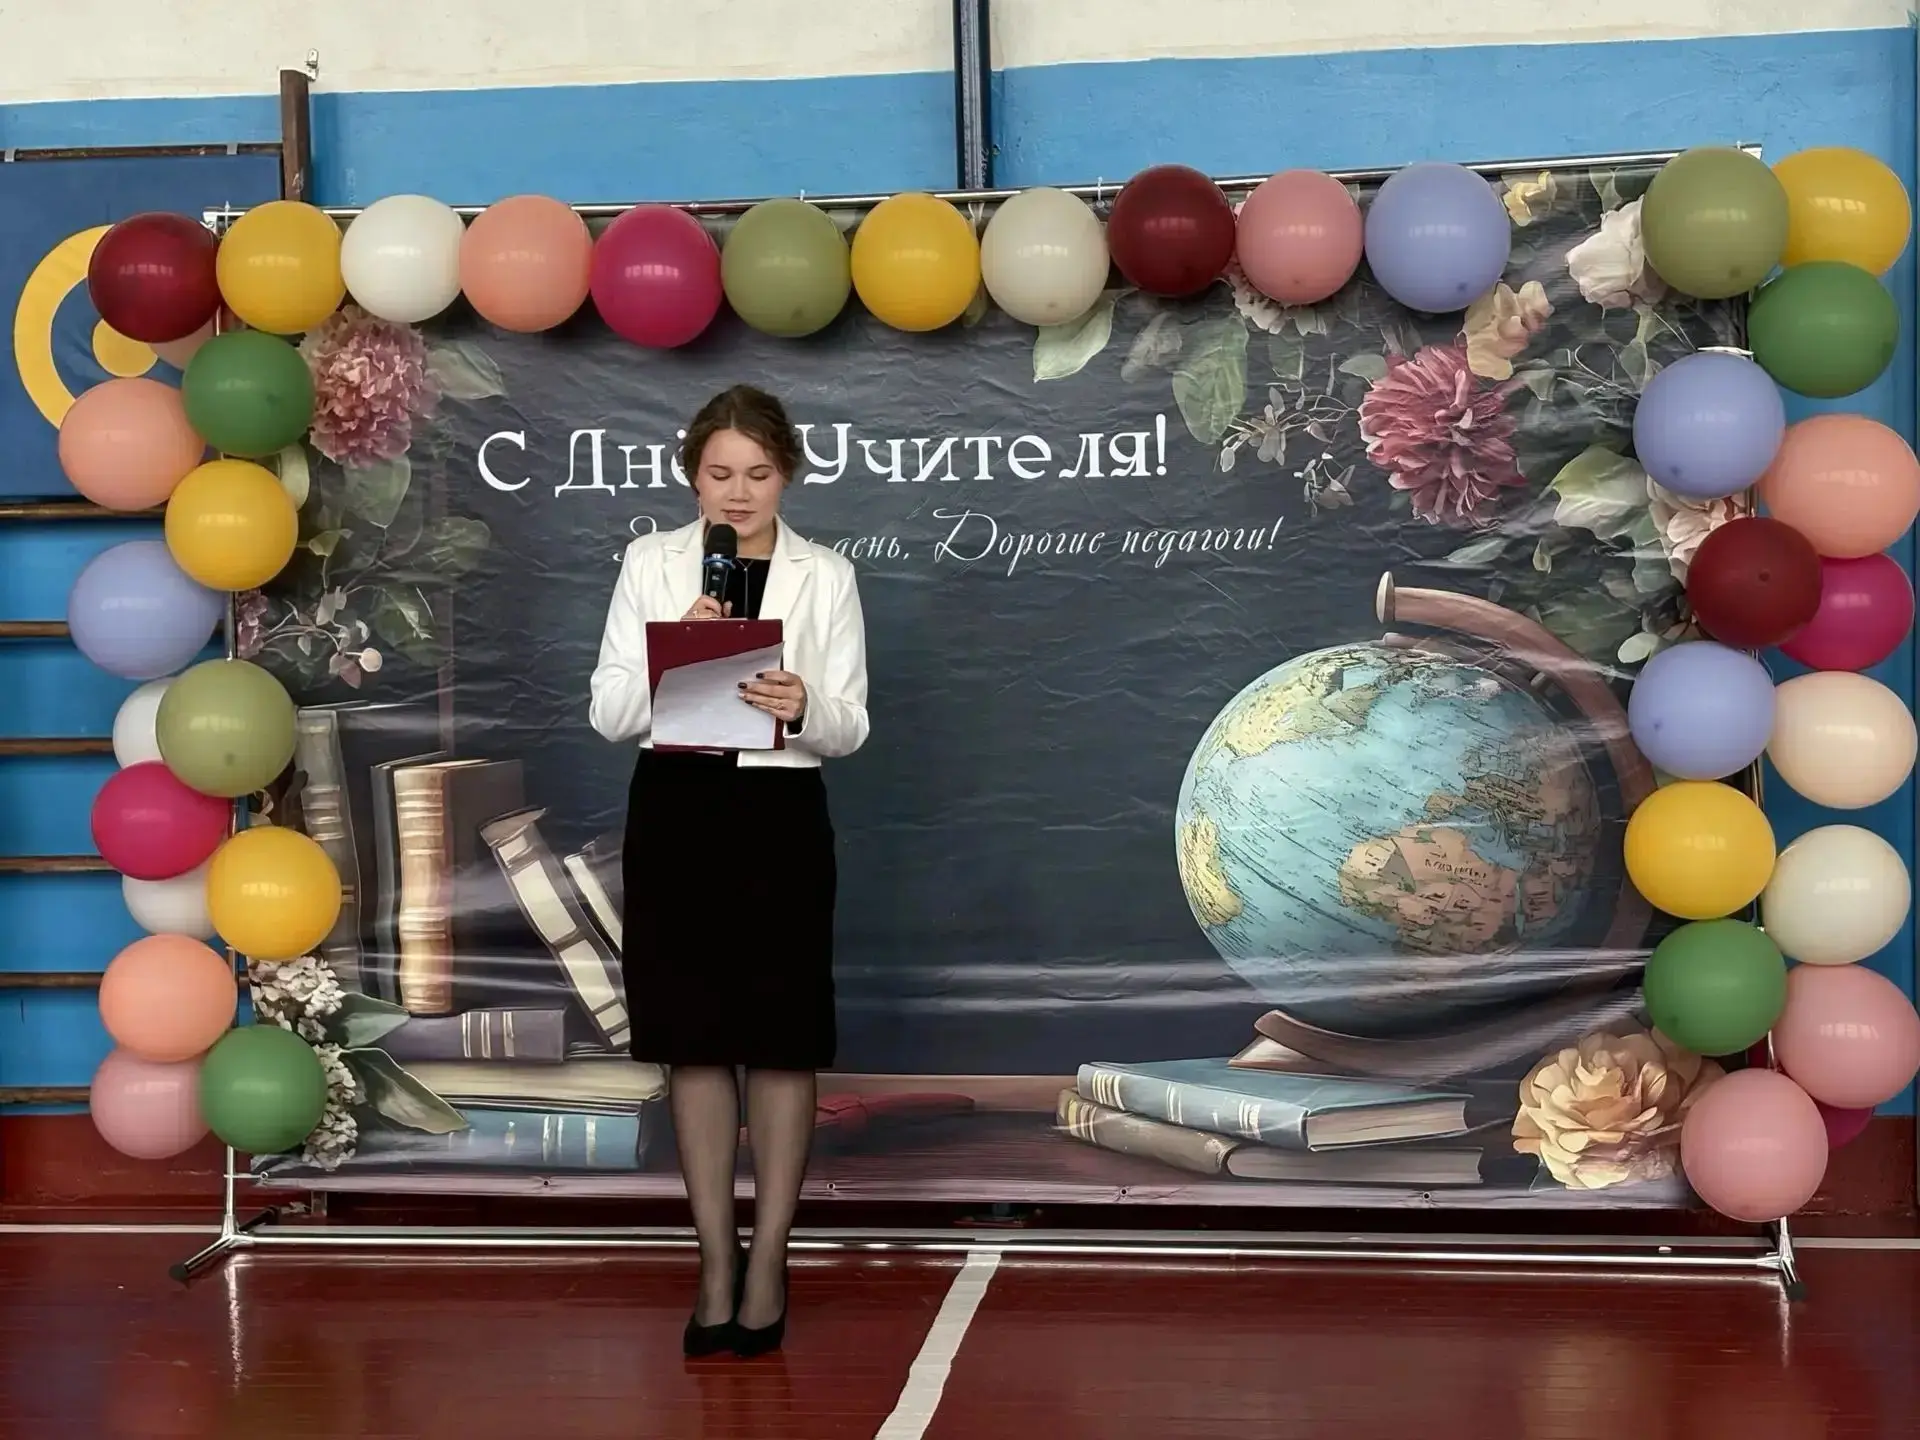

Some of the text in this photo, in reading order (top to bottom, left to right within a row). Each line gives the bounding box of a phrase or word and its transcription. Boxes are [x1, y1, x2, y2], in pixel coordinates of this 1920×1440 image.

[478, 430, 531, 491] С
[794, 413, 1167, 485] Учителя!
[932, 507, 1105, 577] Дорогие
[1121, 515, 1284, 568] педагоги!
